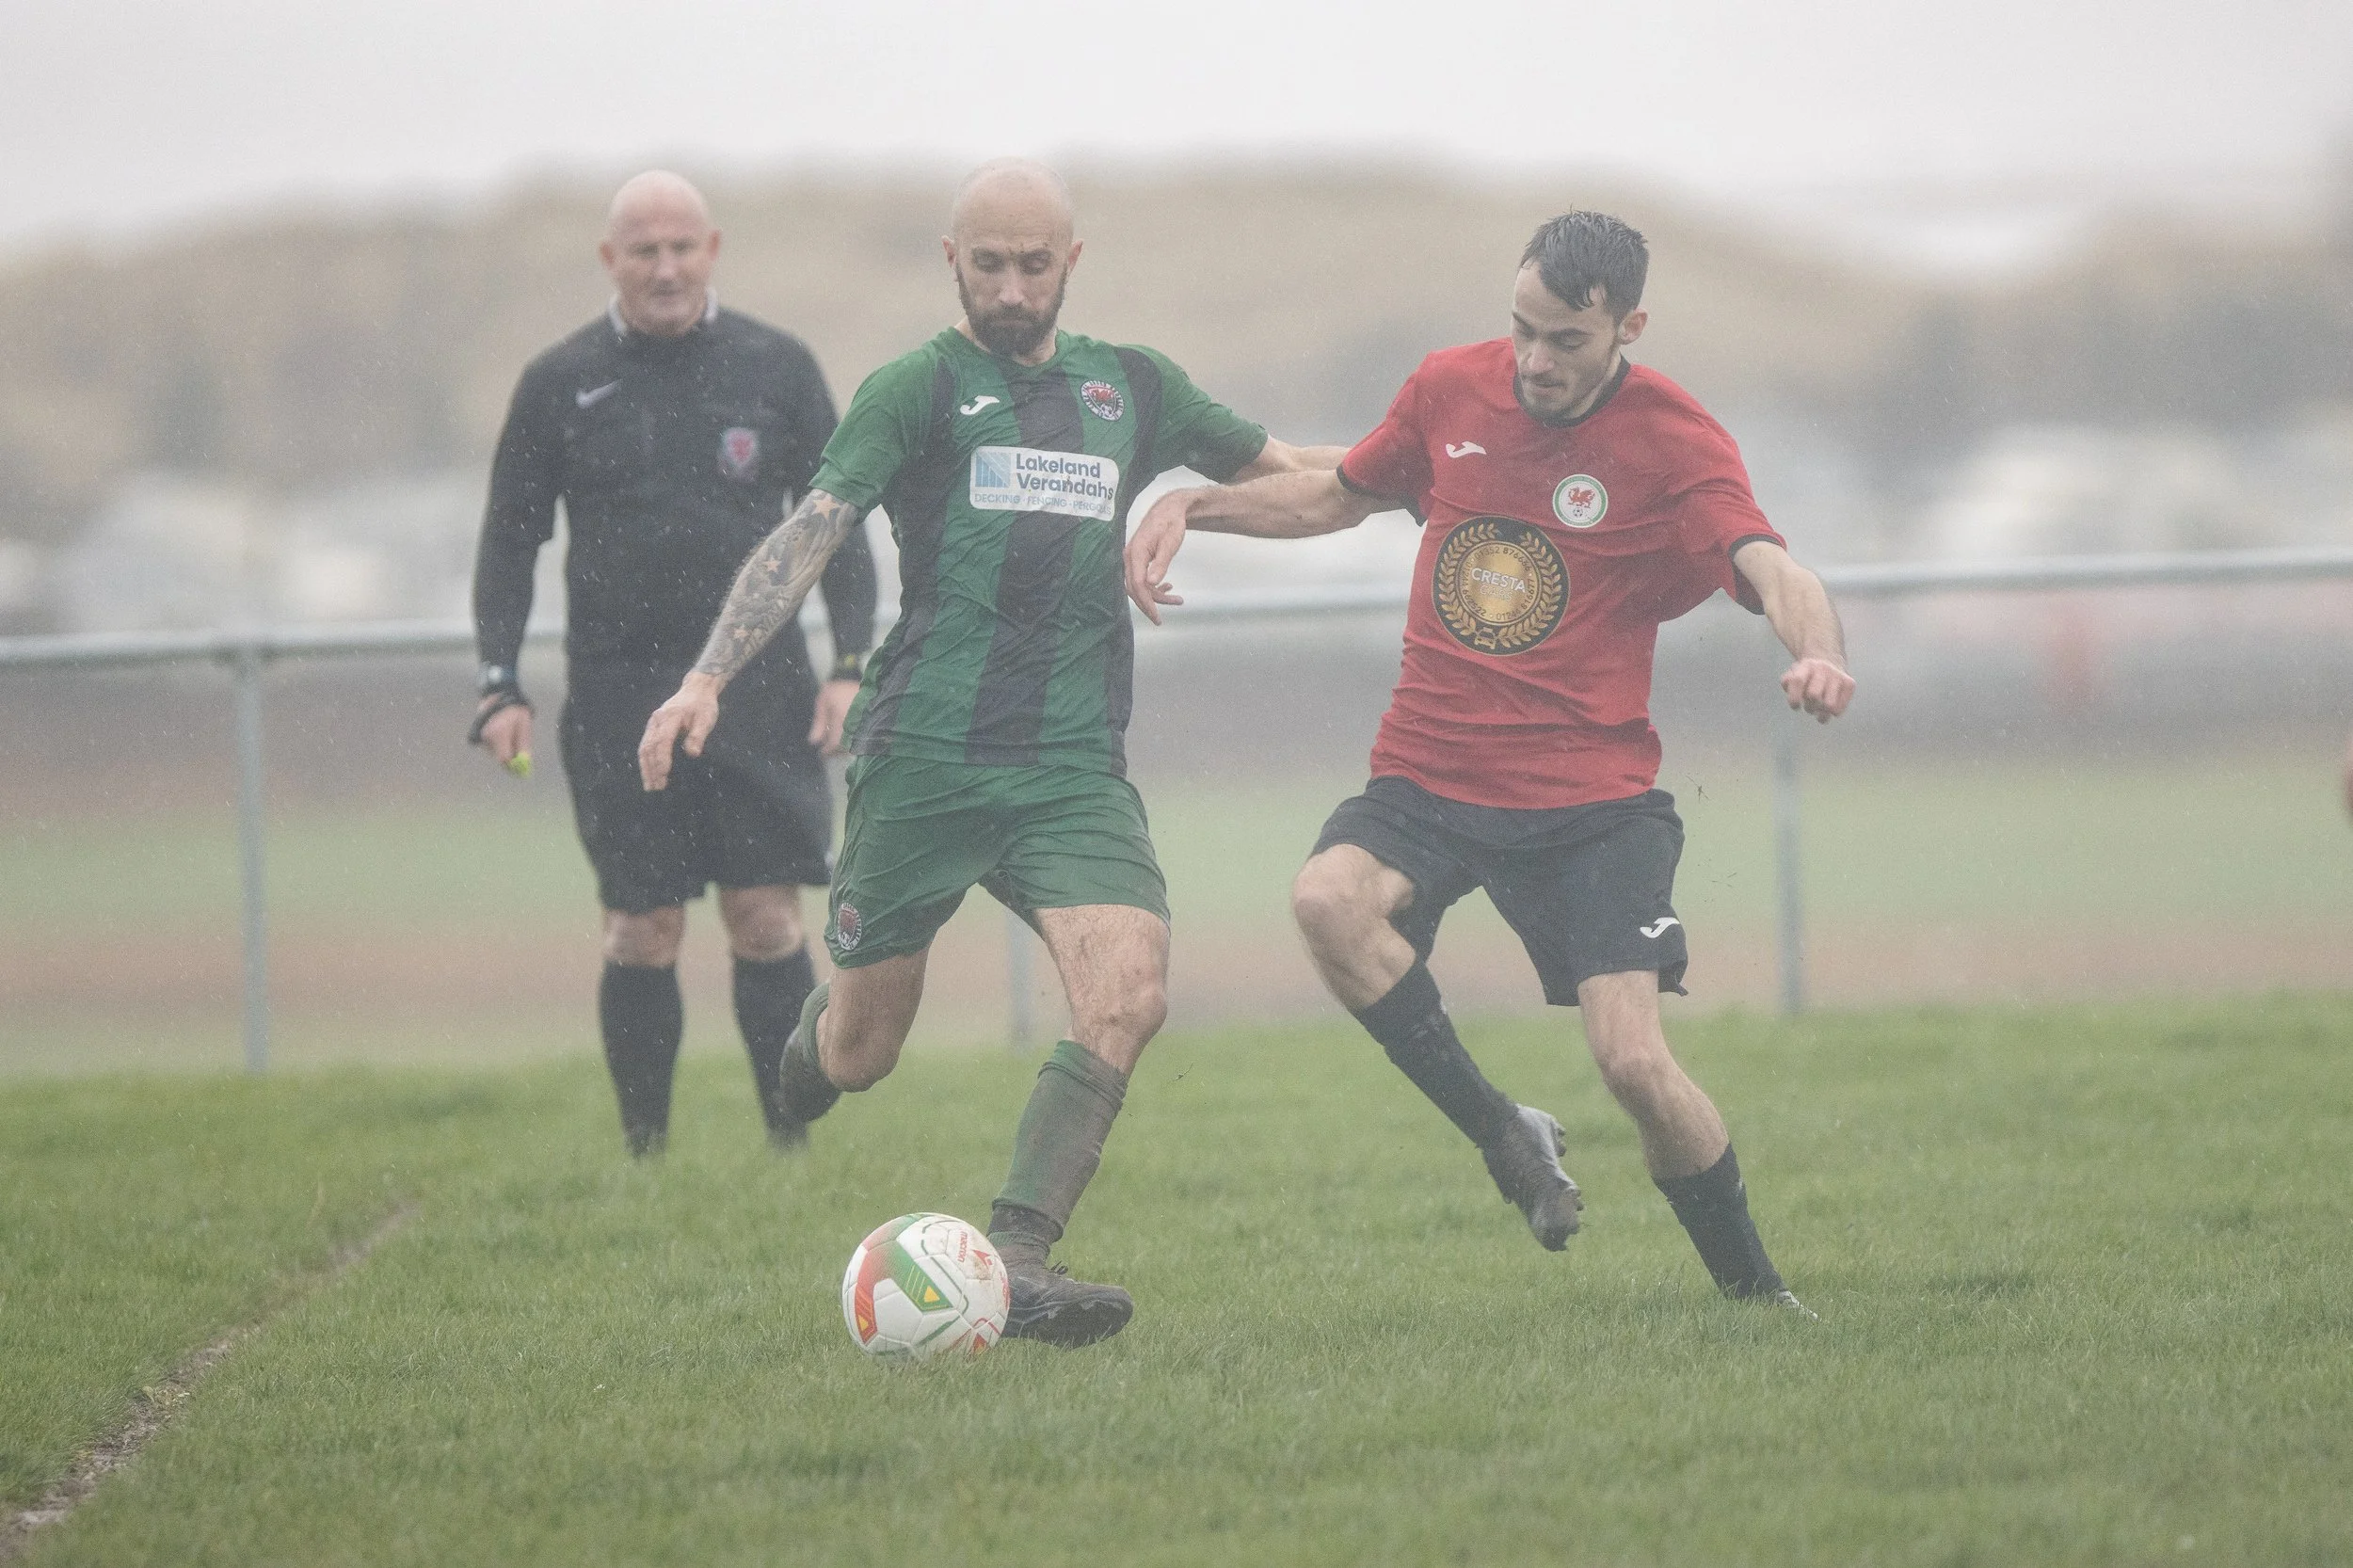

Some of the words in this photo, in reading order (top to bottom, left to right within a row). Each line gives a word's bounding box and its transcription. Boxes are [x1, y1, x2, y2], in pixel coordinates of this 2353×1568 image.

[1016, 453, 1101, 479] Lakeland
[1016, 472, 1114, 501] Verandahs
[974, 493, 1021, 504] DECKING
[1027, 495, 1067, 508] FENCING
[1472, 568, 1526, 593] CRESTA
[1480, 584, 1513, 601] CARS
[958, 1231, 968, 1262] macron
